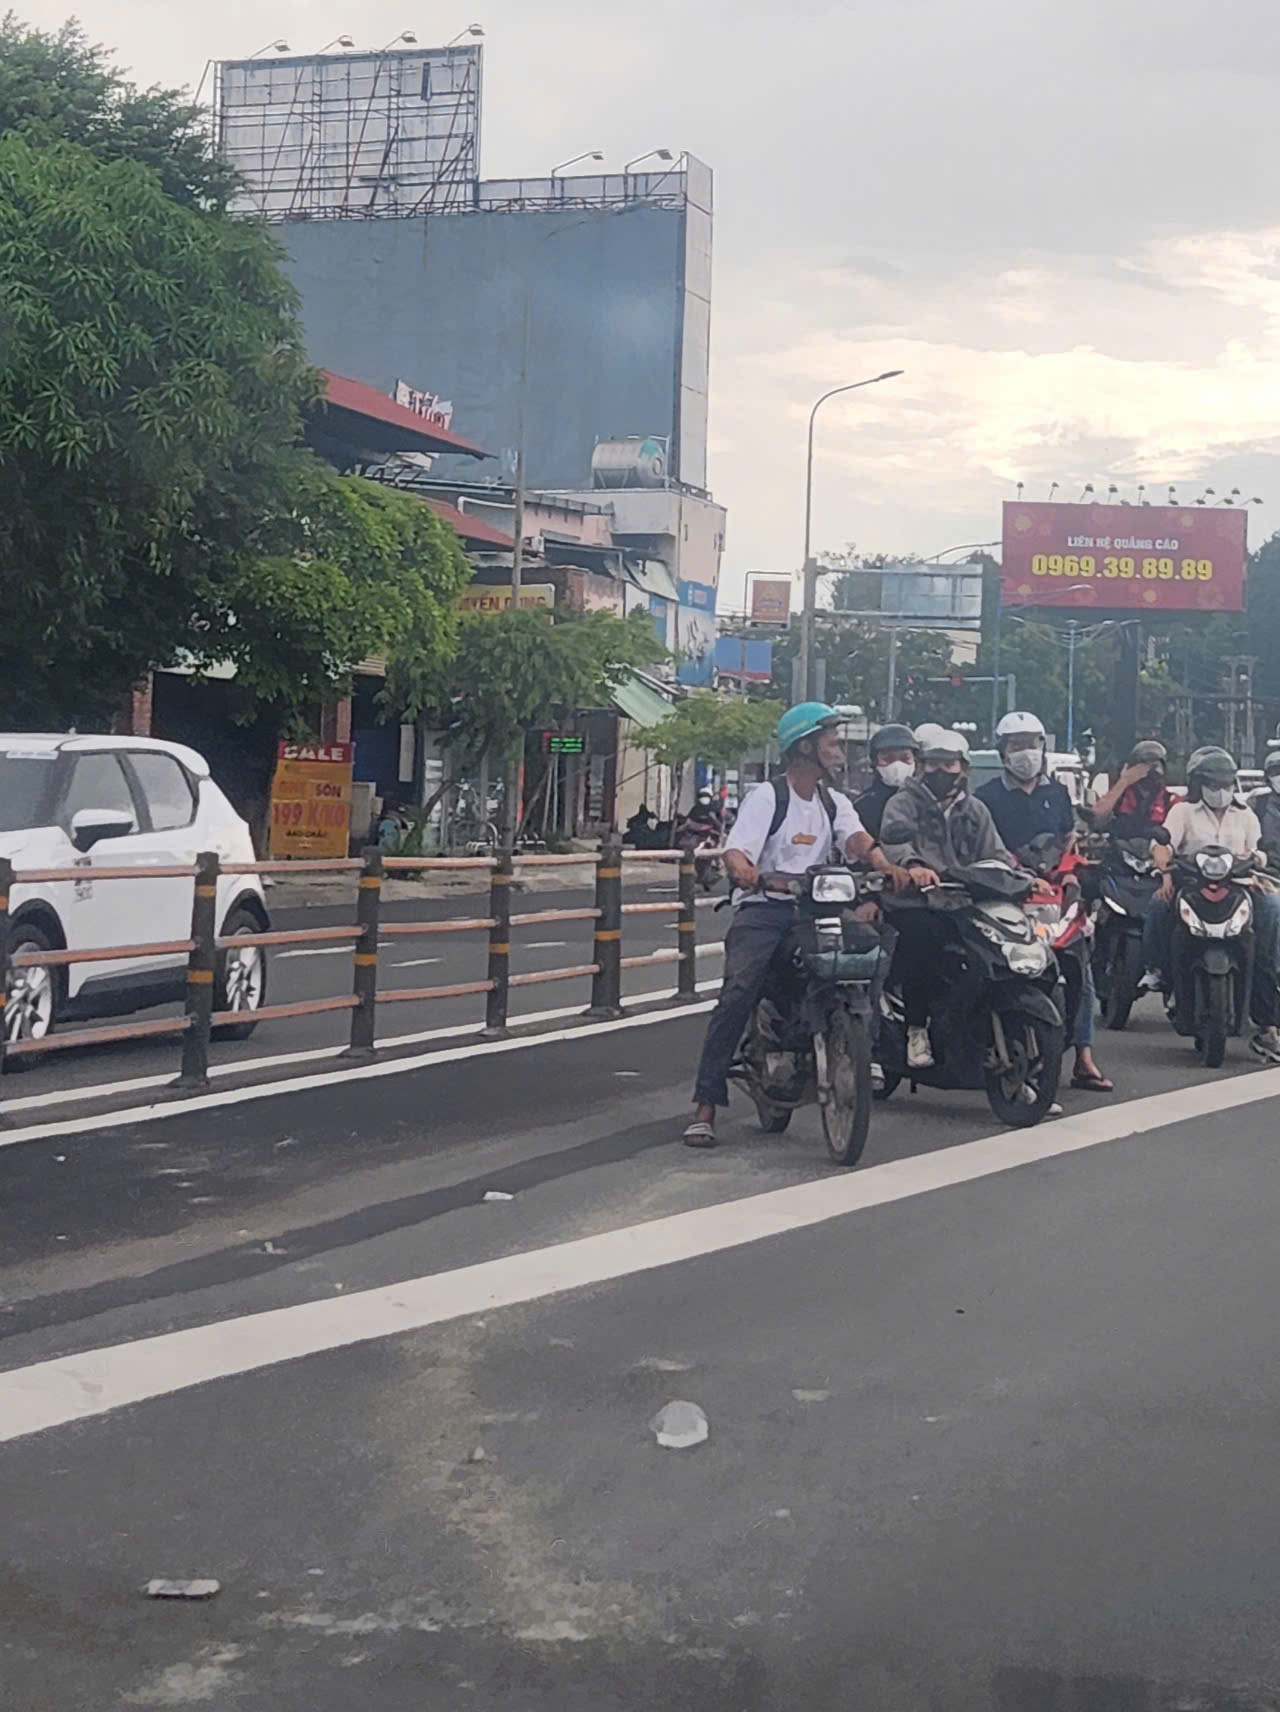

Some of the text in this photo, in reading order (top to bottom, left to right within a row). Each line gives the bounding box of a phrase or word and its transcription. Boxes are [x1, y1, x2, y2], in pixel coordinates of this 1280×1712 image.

[1067, 535, 1179, 550] LIÊN HỆ QUẢNG CÁO
[1031, 554, 1213, 581] 0969.39.89.89
